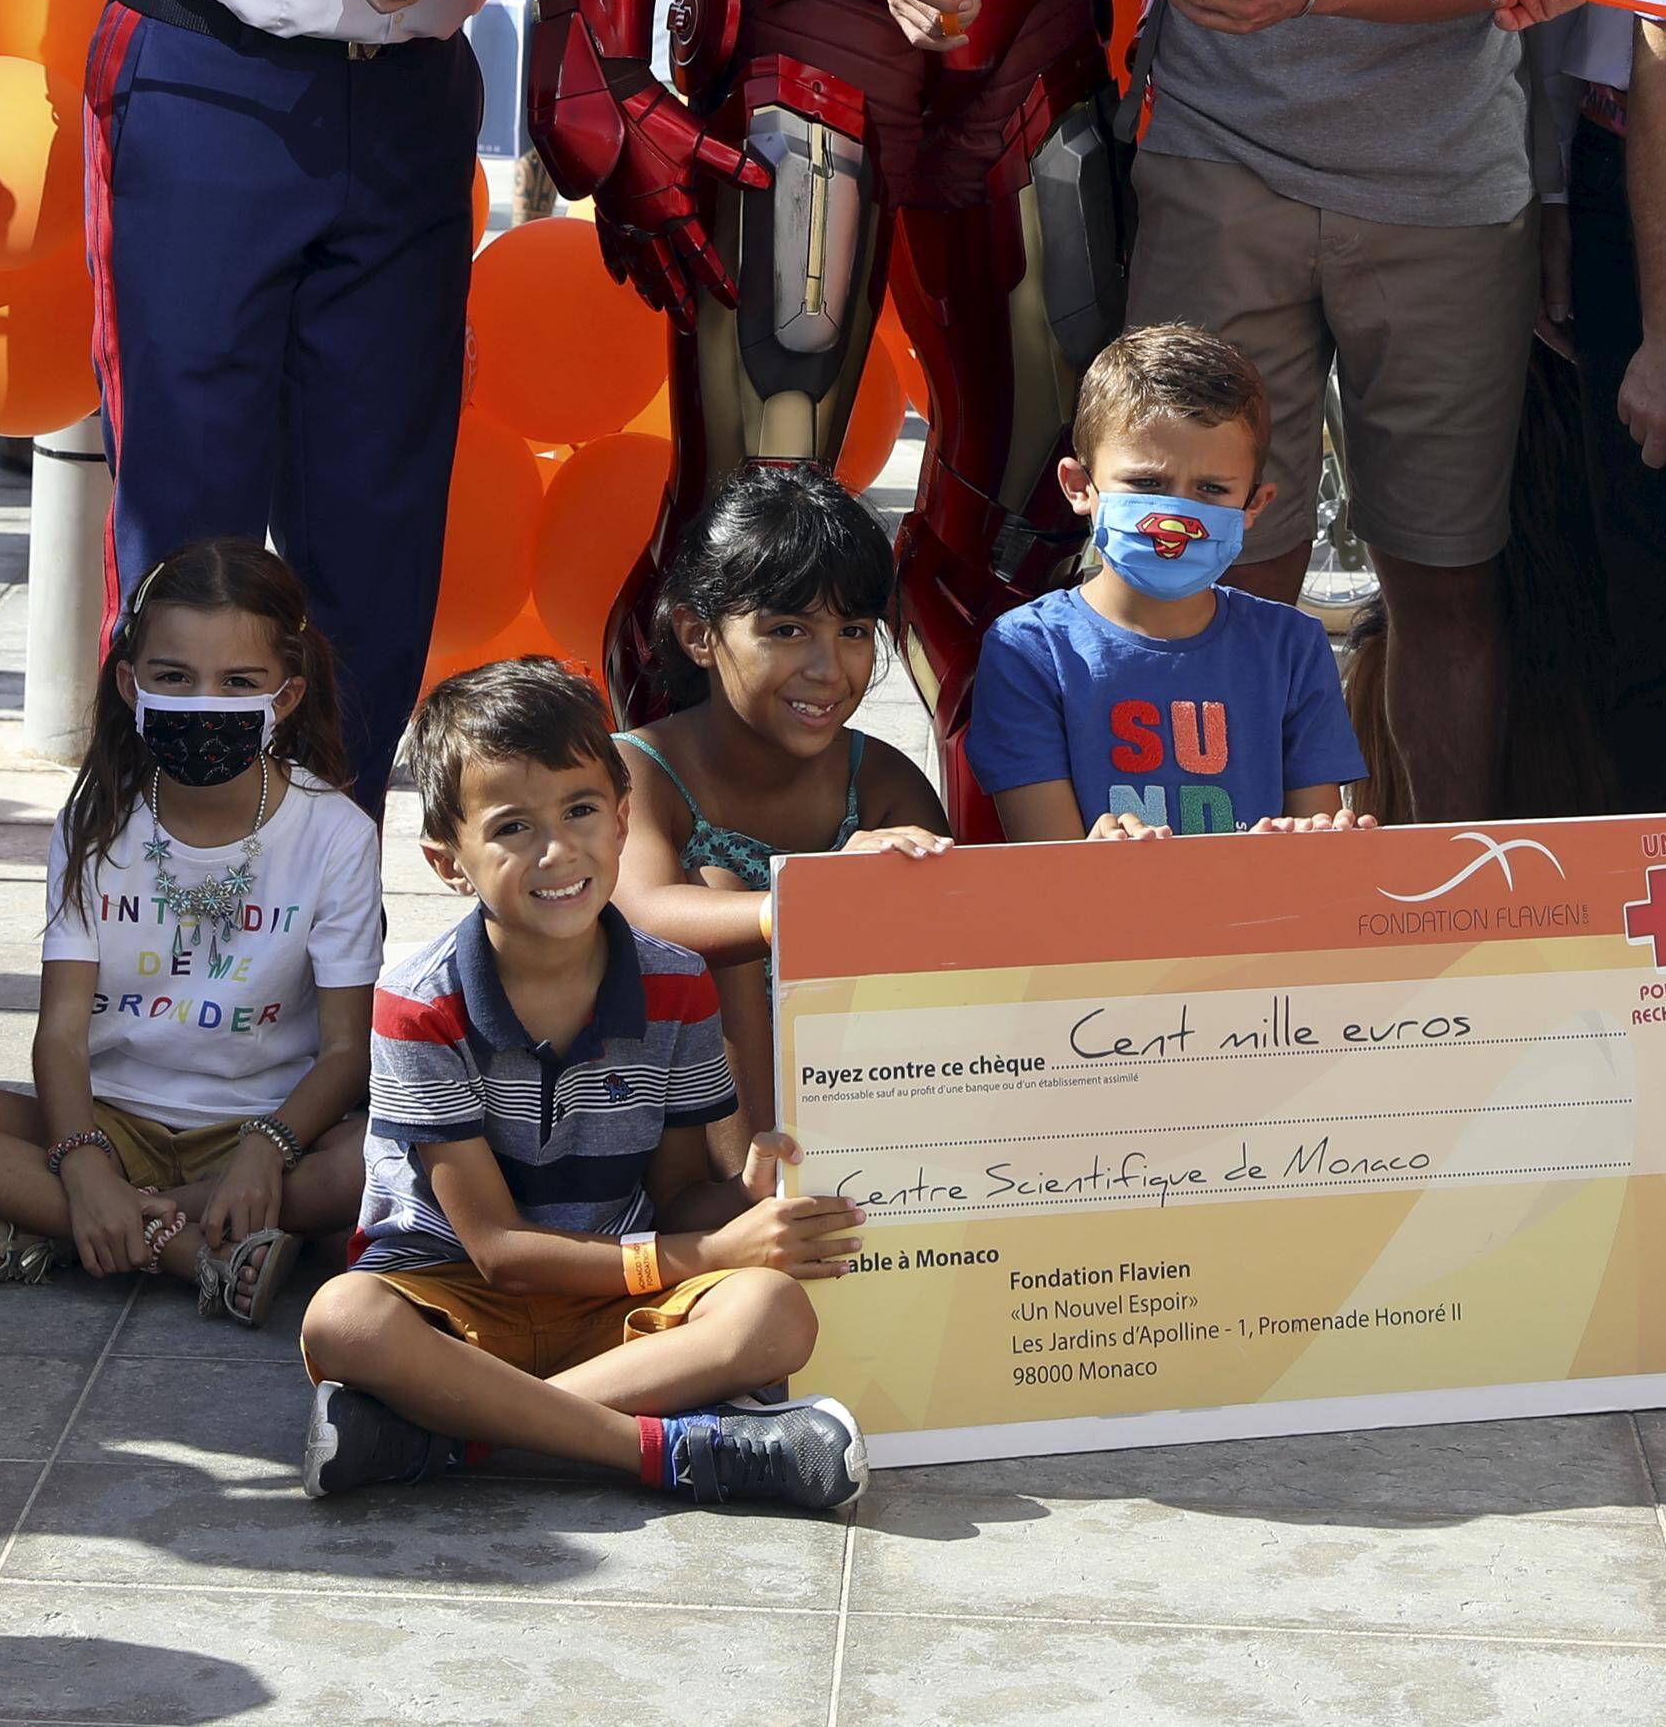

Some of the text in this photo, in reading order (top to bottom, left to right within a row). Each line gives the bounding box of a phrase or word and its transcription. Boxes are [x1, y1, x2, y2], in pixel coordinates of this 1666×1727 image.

[1111, 699, 1229, 775] SU
[101, 894, 301, 934] INTDIT
[1358, 903, 1580, 936] FONDATION FLAVIEN
[138, 951, 254, 982] DE ME
[91, 992, 282, 1032] GRONDER
[1069, 995, 1472, 1059] Cent mille euros
[801, 1093, 820, 1103] non
[822, 1090, 874, 1102] endossable
[876, 1087, 895, 1099] sauf
[897, 1088, 909, 1097] au
[910, 1085, 935, 1098] profit
[966, 1082, 1000, 1094] banque
[1002, 1082, 1014, 1090] ou
[1038, 1073, 1101, 1089] établissement
[1103, 1072, 1139, 1084] assimilé
[802, 1054, 1046, 1089] Payez contre ce chèque
[836, 1136, 1430, 1208] Centre Scientifique de Monaco
[898, 1246, 1000, 1270] à Monaco
[1009, 1260, 1191, 1291] Fondation Flavien
[1010, 1291, 1199, 1323] «Un Nouvel Espoir»
[1012, 1334, 1044, 1355] Les
[1048, 1326, 1118, 1352] Jardins
[1237, 1318, 1253, 1339] 1,
[1259, 1309, 1370, 1338] Promenade
[1375, 1302, 1446, 1327] Honoré
[1451, 1302, 1462, 1322] II
[1013, 1359, 1158, 1387] 98000 Monaco
